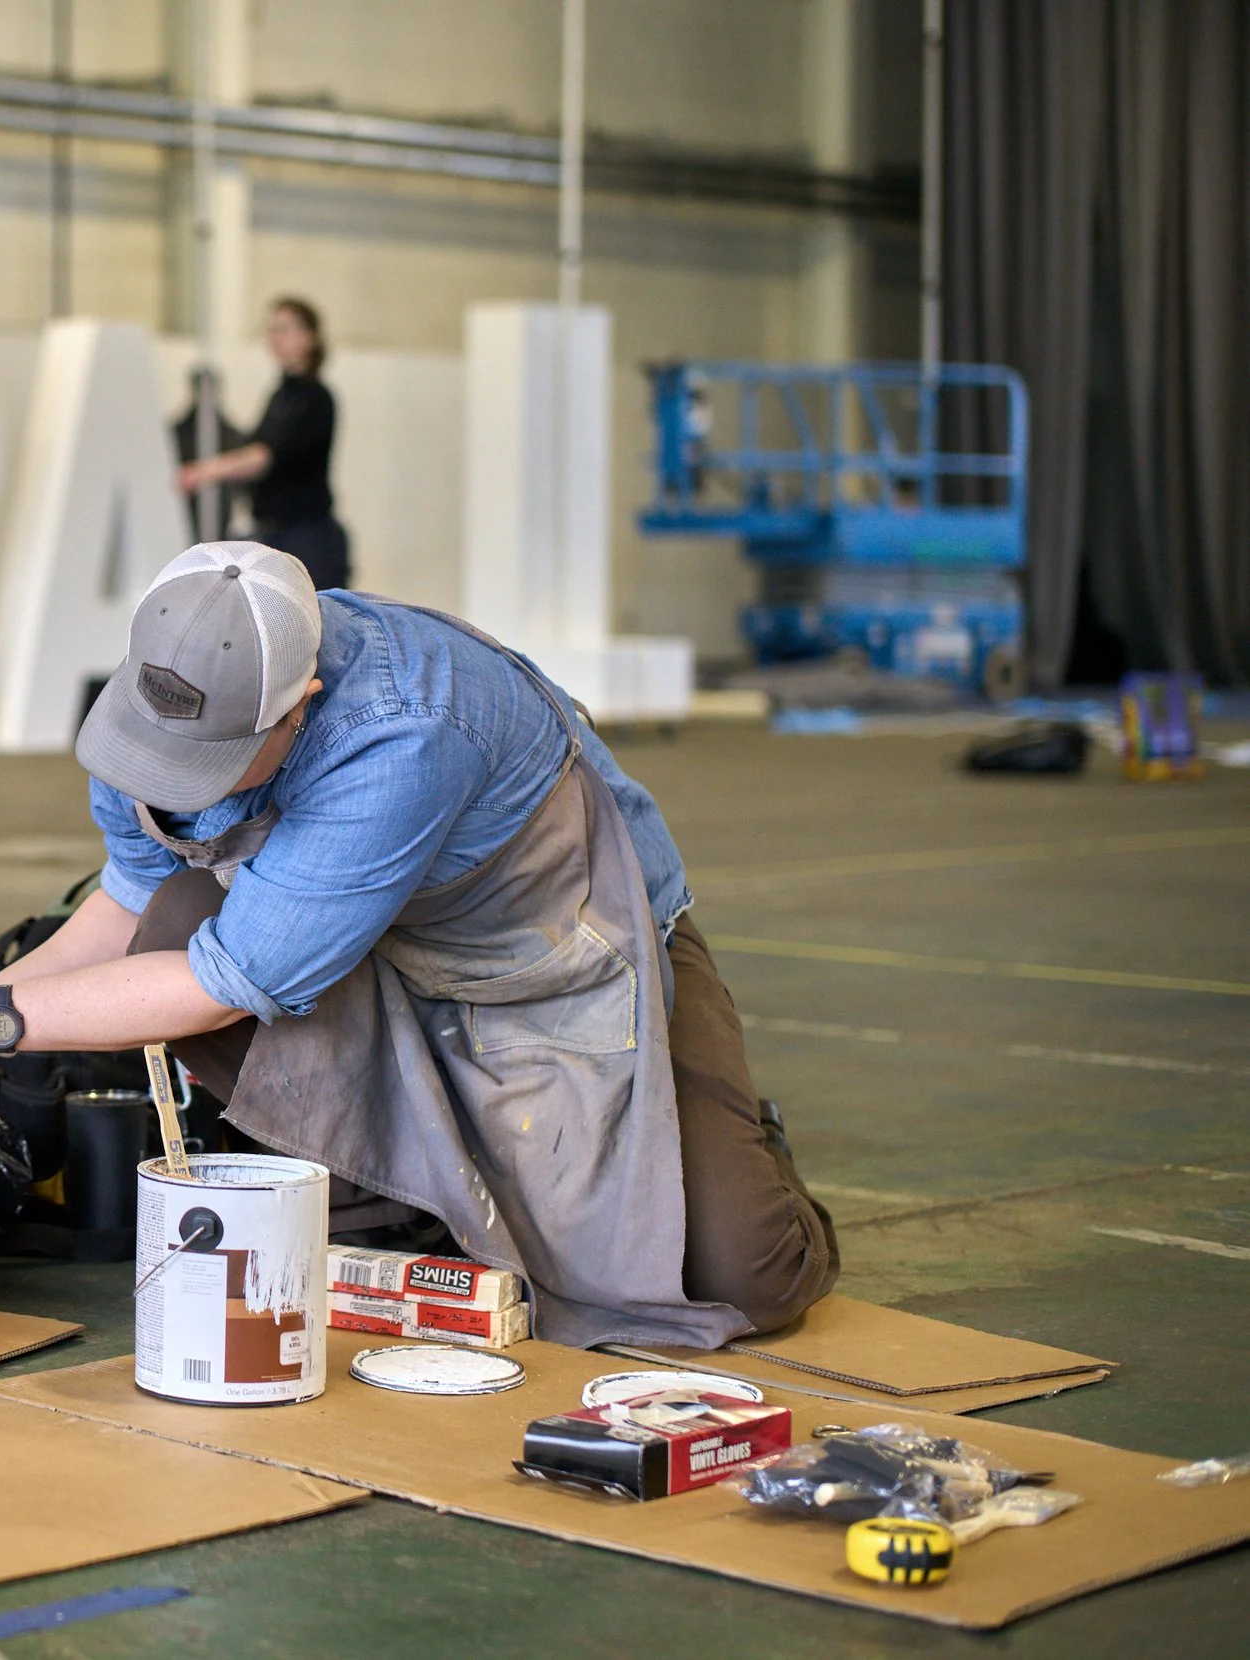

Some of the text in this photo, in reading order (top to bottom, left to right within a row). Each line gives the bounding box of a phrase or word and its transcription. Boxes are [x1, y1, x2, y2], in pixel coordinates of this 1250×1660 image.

[412, 1264, 472, 1288] SHIMS
[226, 1387, 241, 1396] One
[242, 1387, 265, 1396] Gallon
[690, 1441, 752, 1472] VINYL GLOVES
